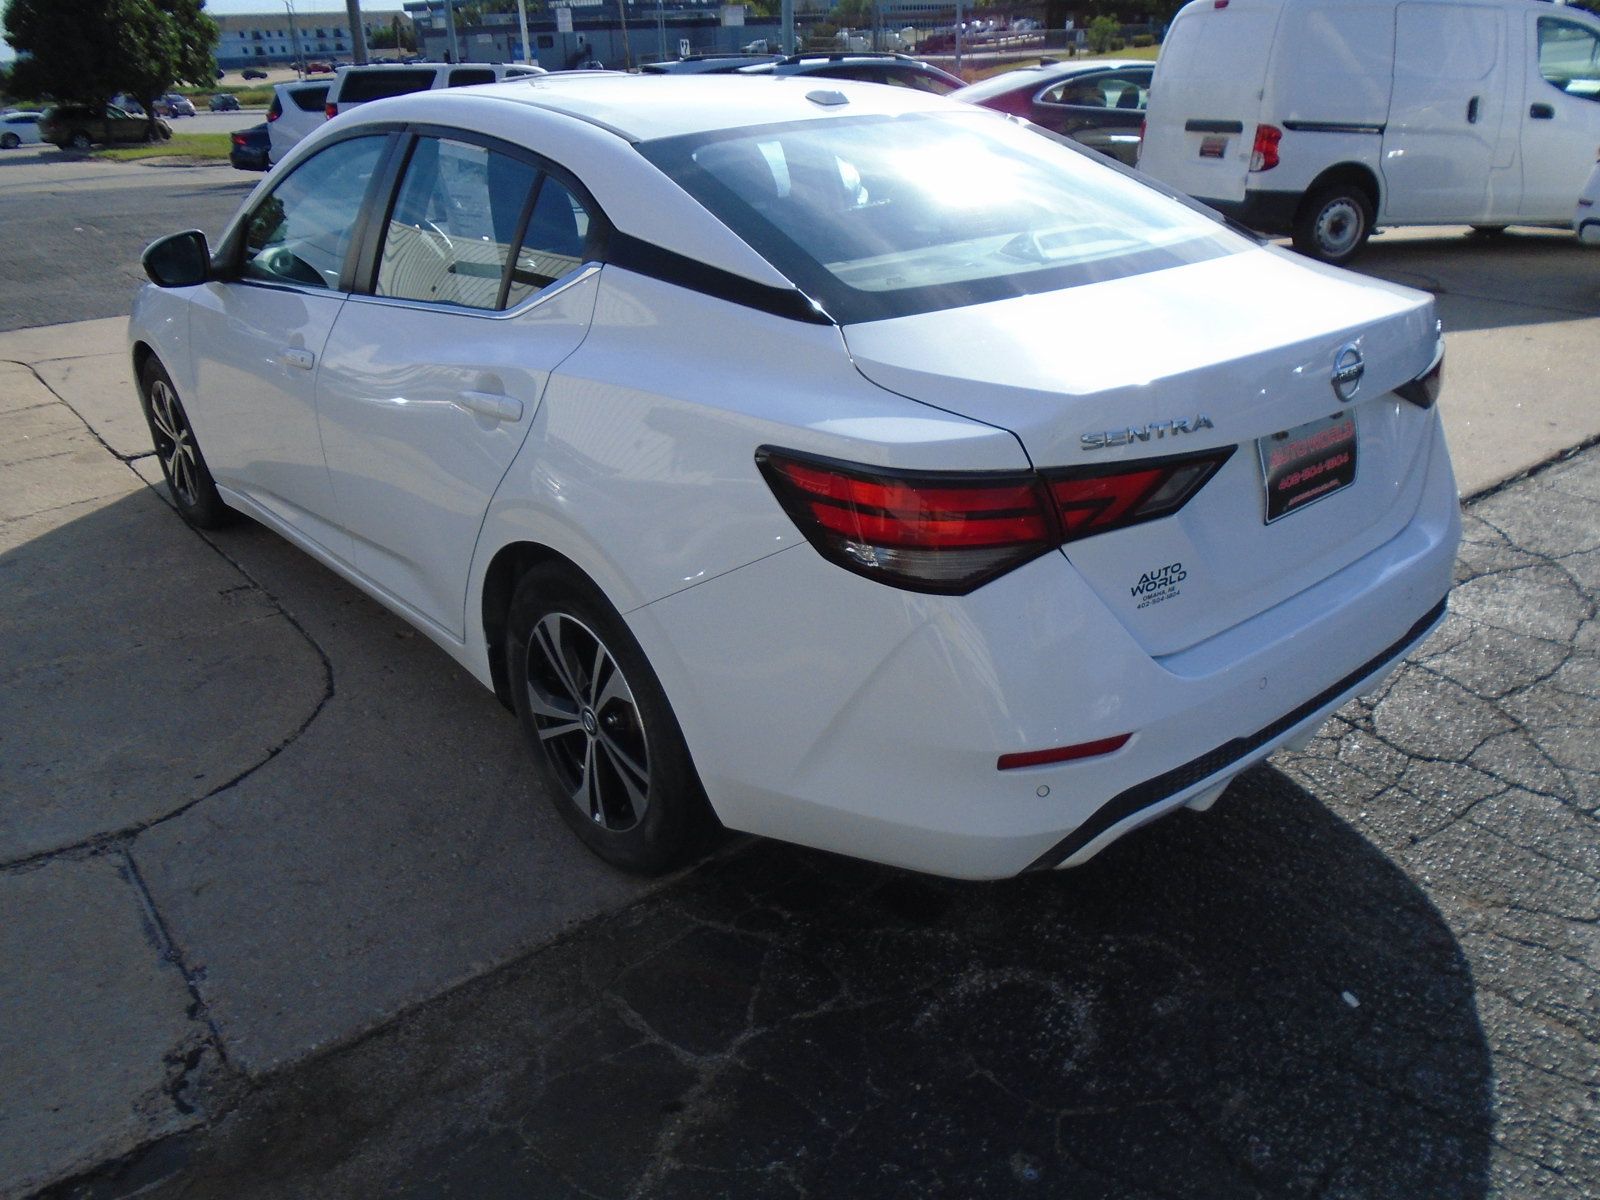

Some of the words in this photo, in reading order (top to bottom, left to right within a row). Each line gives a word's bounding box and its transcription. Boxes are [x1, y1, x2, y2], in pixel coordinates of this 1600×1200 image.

[1080, 414, 1214, 451] SENTRA
[1130, 571, 1187, 597] WORLD
[1138, 562, 1182, 585] AUTO
